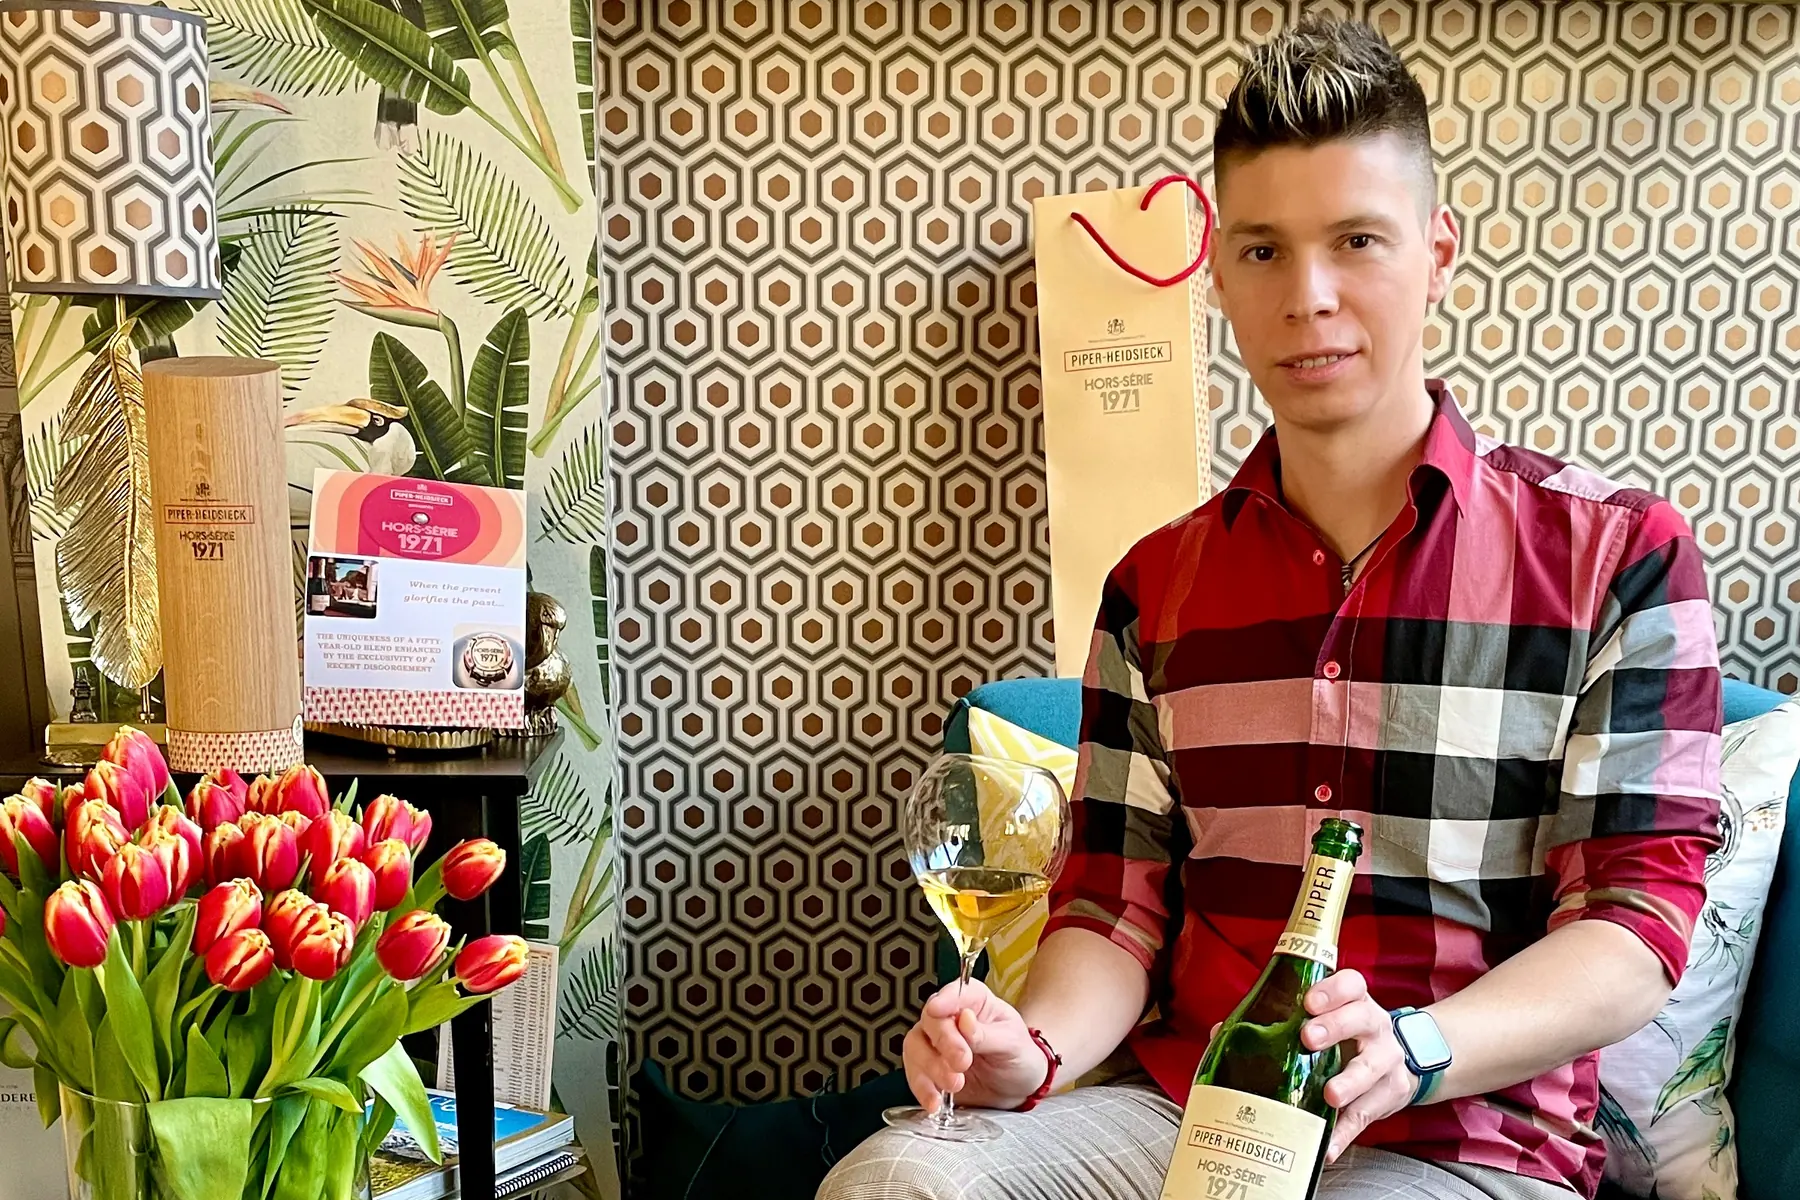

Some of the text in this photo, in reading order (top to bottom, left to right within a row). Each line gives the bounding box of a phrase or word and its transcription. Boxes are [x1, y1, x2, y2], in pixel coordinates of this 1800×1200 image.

[1071, 346, 1164, 367] PIPER-HEIDSIECK
[1084, 373, 1153, 391] HORS-SÉRIE
[1100, 389, 1140, 411] 1971
[394, 491, 449, 503] PIPER-HEIDSIECK
[167, 509, 246, 521] PIPER-HEIDSIECK
[381, 521, 459, 538] HORS-SÉRIE
[192, 541, 224, 557] 1971
[398, 533, 442, 552] 1971
[409, 580, 502, 594] When the present
[403, 594, 448, 604] glorifies
[452, 597, 469, 605] the
[336, 634, 391, 643] UNIQUENESS
[318, 642, 441, 654] YEAR-OLD BLEND ENHANCED
[323, 652, 333, 660] BY
[357, 654, 413, 663] EXCLUSIVITY
[480, 653, 498, 662] 1971
[326, 662, 432, 673] RECENT DISGORGEMENT
[1304, 866, 1336, 922] PIPER
[1288, 937, 1318, 957] 1971
[1194, 1130, 1287, 1166] PIPER-HEIDSIECK
[1197, 1158, 1267, 1187] HORS-SÉRIE
